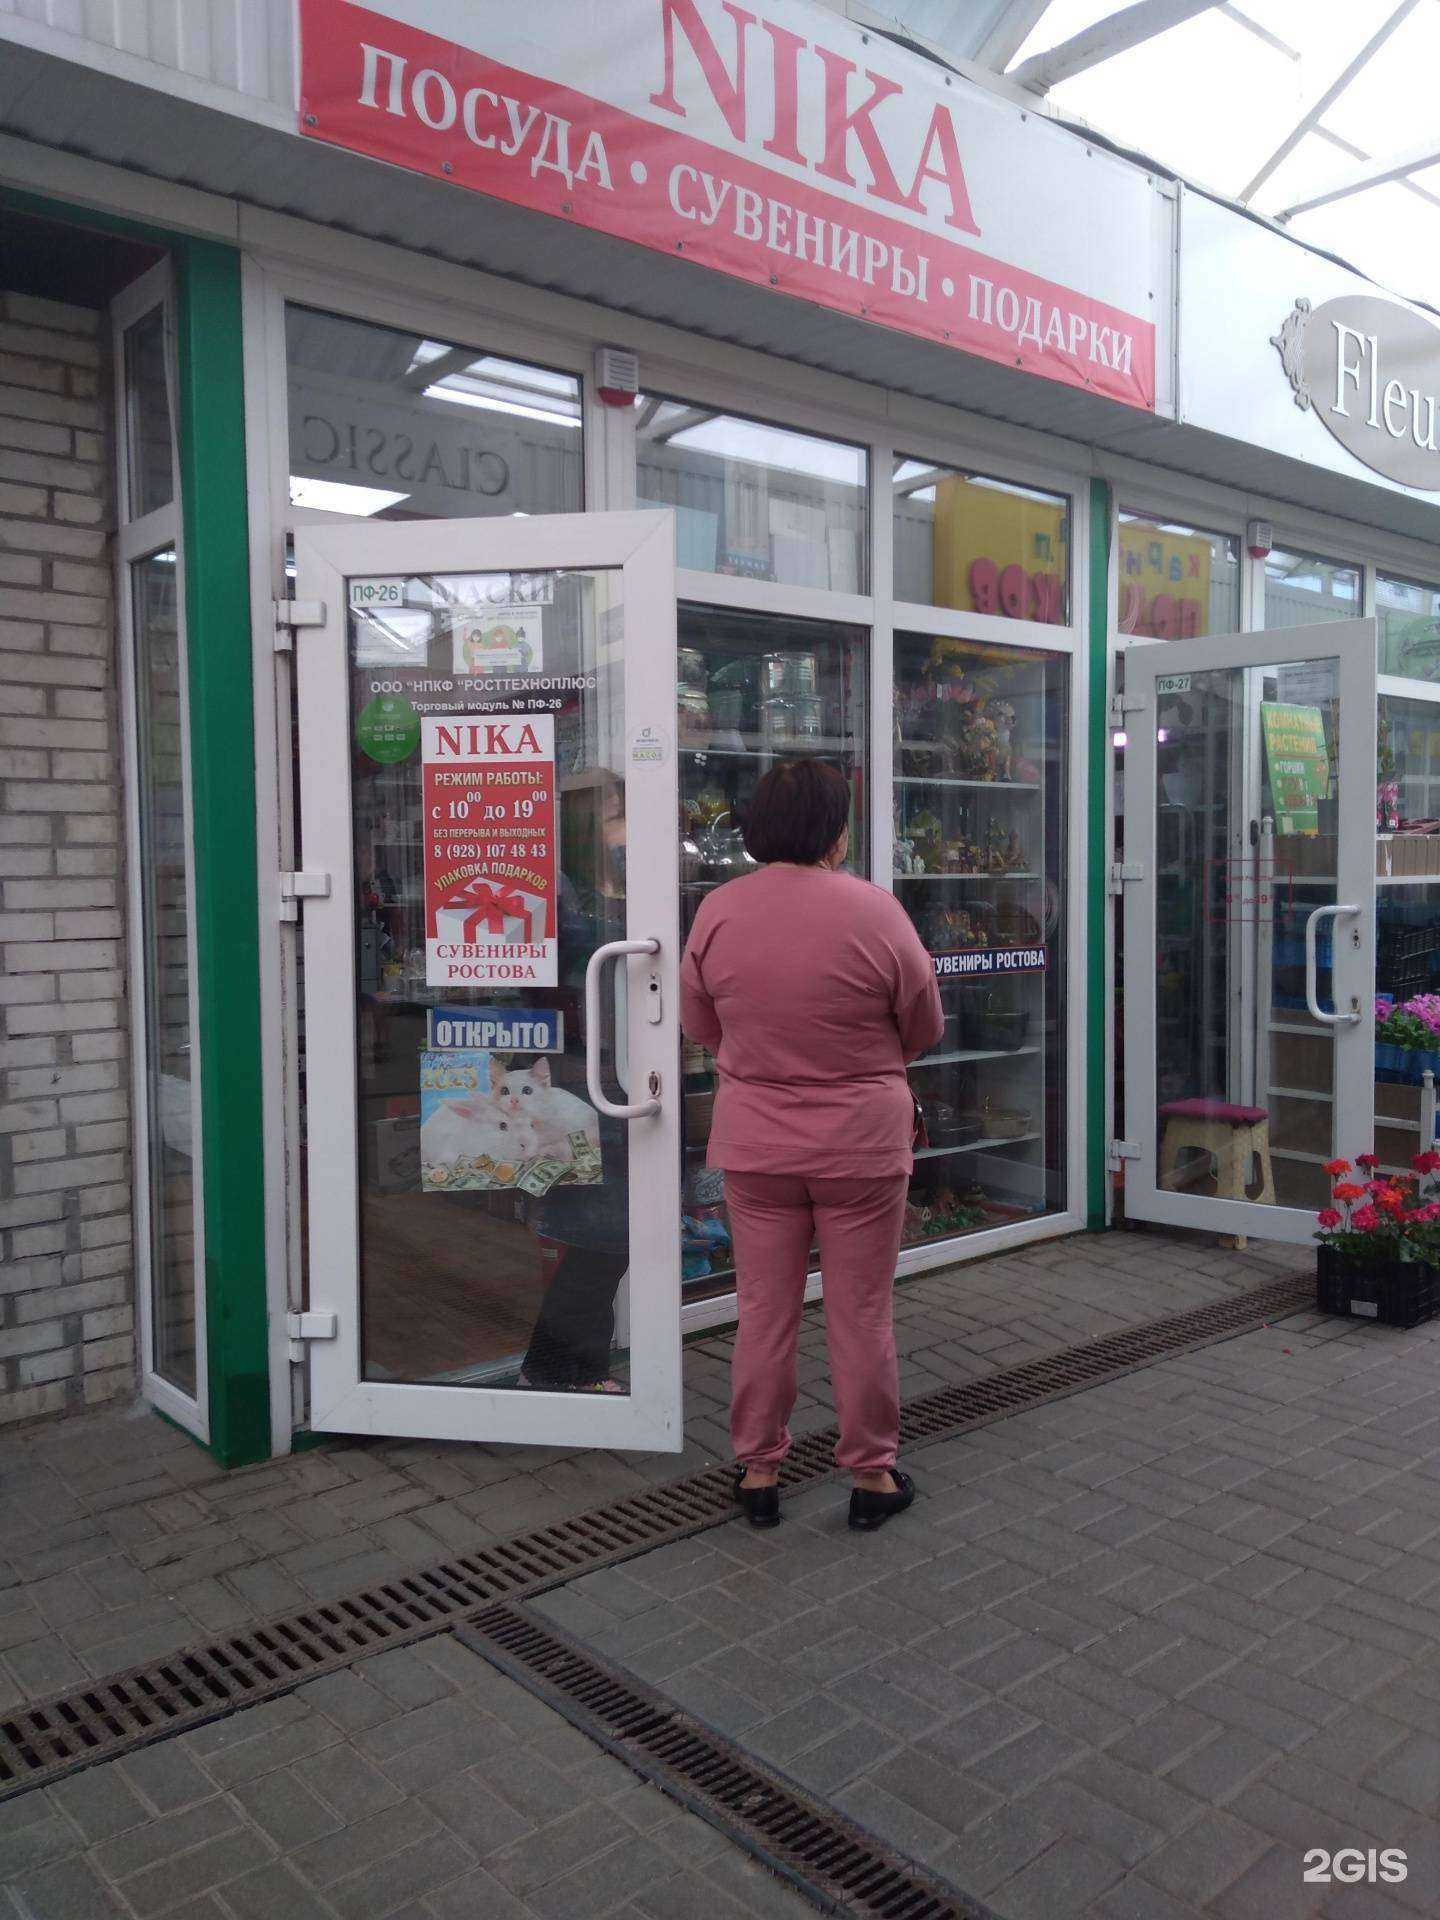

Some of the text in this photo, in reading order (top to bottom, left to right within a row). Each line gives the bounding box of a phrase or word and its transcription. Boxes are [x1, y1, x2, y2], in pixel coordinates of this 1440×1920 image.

[649, 0, 982, 238] NIKA
[356, 42, 1133, 376] ПОСУДА СУВЕНИРЫ ПОДАРКИ
[1330, 320, 1440, 451] Fleu
[353, 584, 398, 601] ПФ-26
[370, 680, 403, 693] ООО
[1158, 678, 1189, 691] ПФ-27
[410, 700, 465, 713] Торговый
[467, 700, 510, 712] модуль
[527, 699, 562, 709] ПФ-26
[435, 723, 543, 756] NIKA
[434, 771, 543, 786] РЕЖИМ РАБОТЫ:
[483, 805, 506, 820] до
[433, 829, 448, 838] БЕЗ
[449, 828, 491, 838] ПЕРЕРЫВА
[500, 828, 546, 838] ВЫХОДНЫХ
[434, 843, 547, 860] 8 (928) 107 48 43
[434, 861, 548, 891] УПАКОВКА ПОДАРКОВ
[436, 944, 547, 960] СУВЕНИРЫ
[996, 950, 1045, 969] РОСТОВА
[447, 964, 536, 979] РОСТОВА
[436, 1020, 549, 1049] ОТКРЫТО
